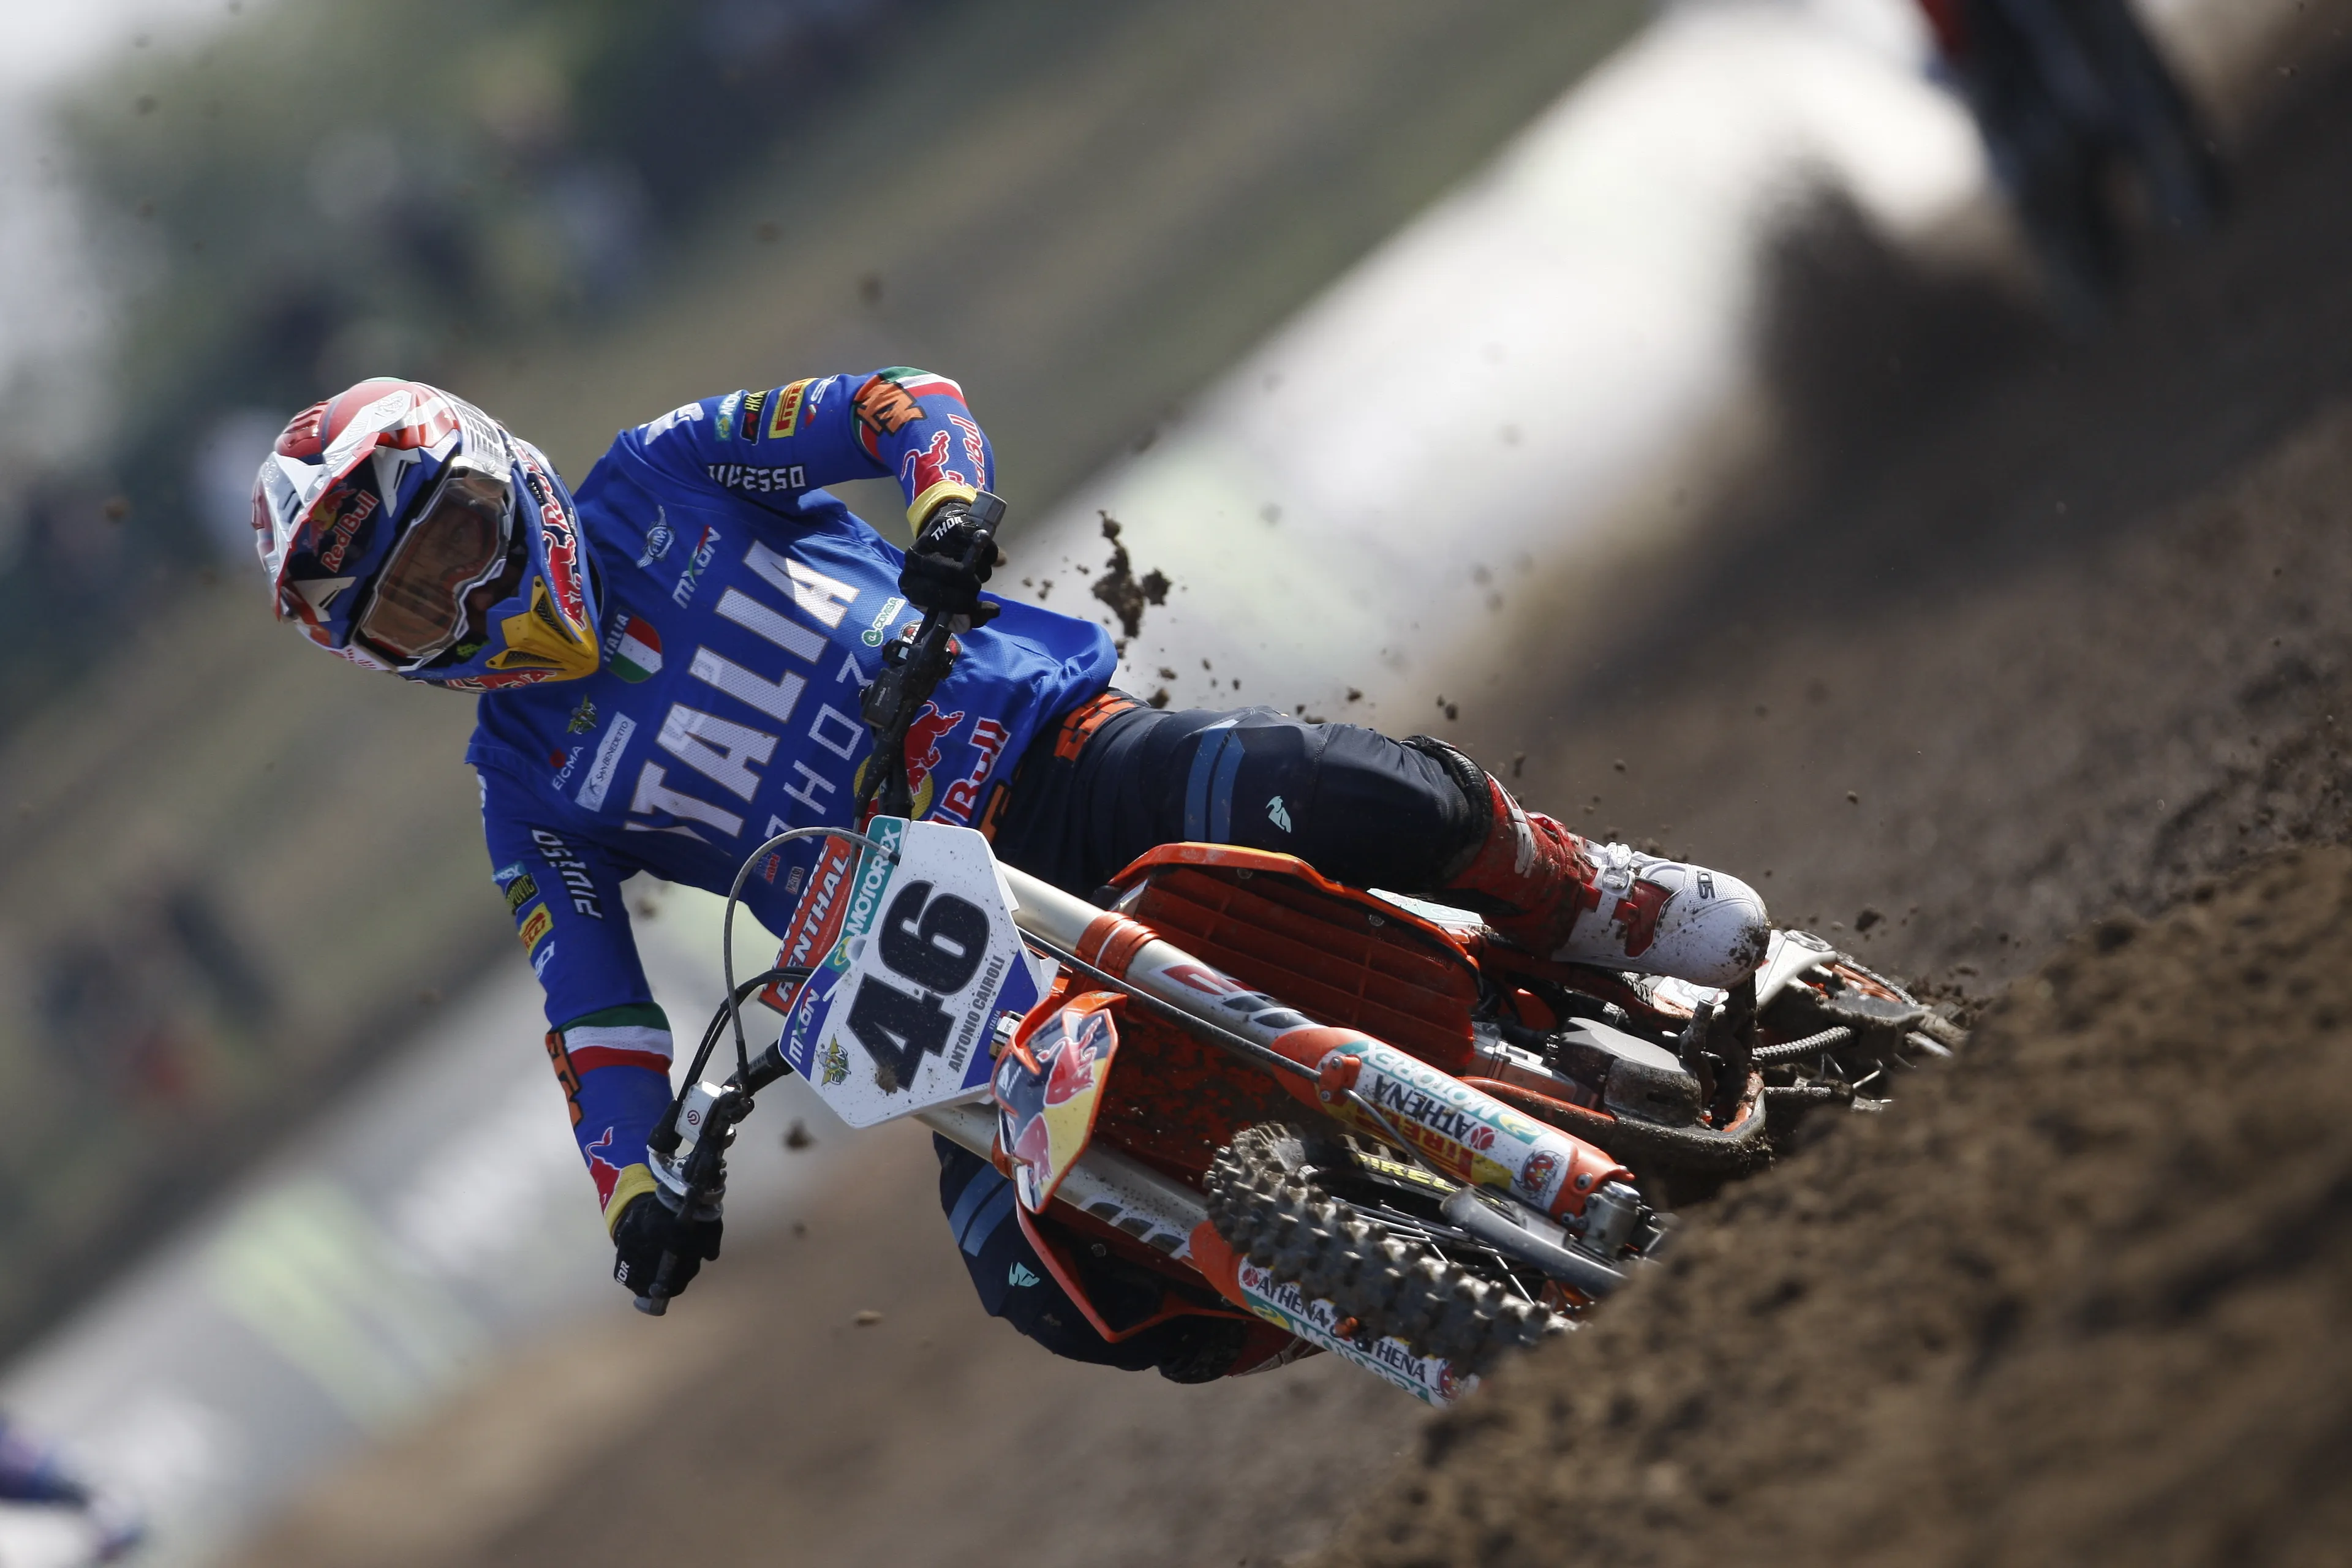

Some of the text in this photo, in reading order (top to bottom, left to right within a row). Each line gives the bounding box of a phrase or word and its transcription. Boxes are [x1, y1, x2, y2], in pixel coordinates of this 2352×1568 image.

[929, 515, 963, 543] THOR
[603, 614, 628, 662] ITALIA
[551, 745, 584, 791] EICMA
[846, 879, 990, 1091] 46
[948, 955, 1006, 1073] ANTONIO CAIROLI
[788, 987, 817, 1065] MXON
[1373, 1073, 1471, 1140] ATHENA
